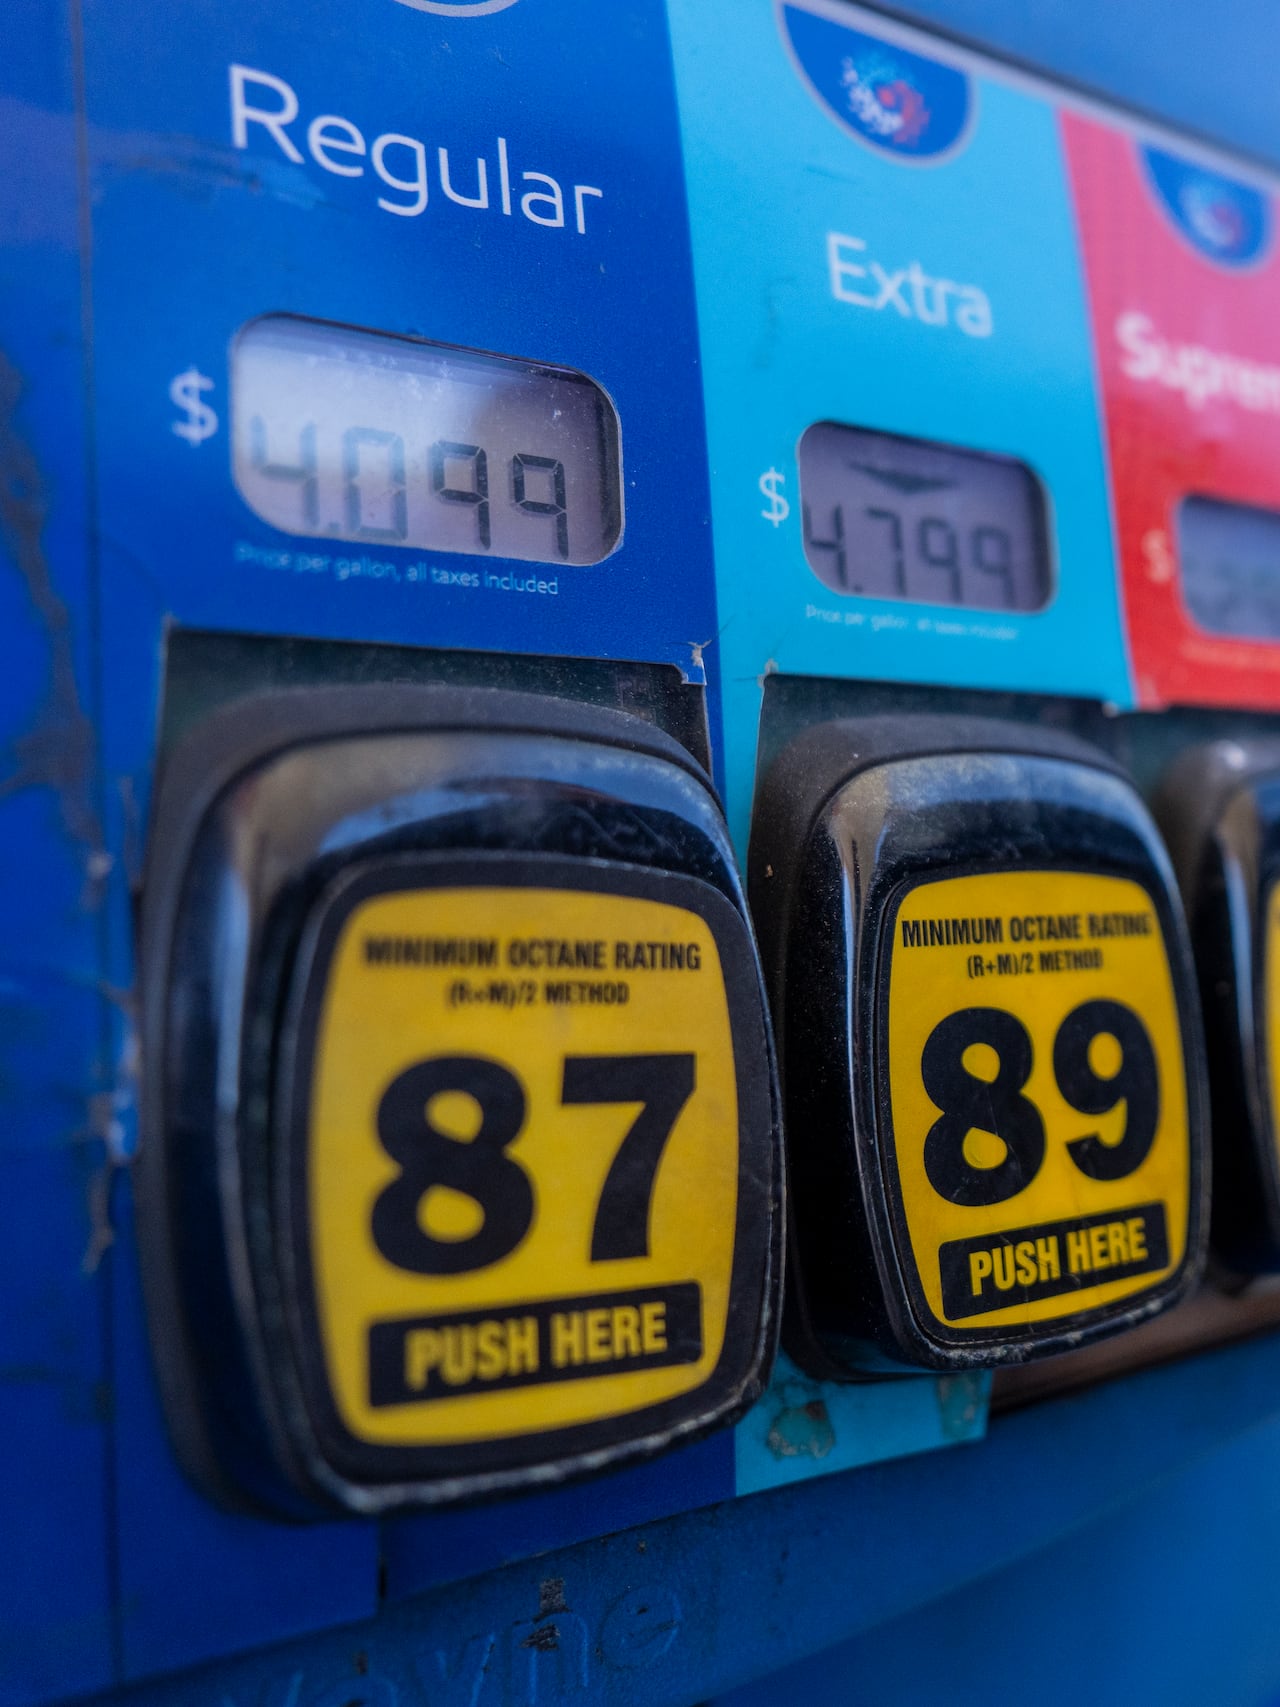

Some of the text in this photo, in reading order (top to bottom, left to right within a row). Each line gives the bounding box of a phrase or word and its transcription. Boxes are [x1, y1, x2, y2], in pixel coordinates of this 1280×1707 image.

[230, 63, 602, 233] Regular
[826, 231, 993, 338] Extra
[169, 367, 569, 559] $ 4.099
[234, 540, 559, 595] Price per gallon, all taxes included
[758, 467, 1017, 605] $ 4.799
[364, 936, 701, 971] MINIMUM OCTANE RATING
[902, 910, 1153, 948] MINIMUM OCTANE RATING
[967, 948, 1104, 979] (R+M)/2 METHOD
[450, 979, 630, 1011] (R+M)/2 METHOD
[921, 997, 1162, 1207] 89
[368, 1051, 697, 1279] 87
[968, 1217, 1149, 1296] PUSH HERE
[406, 1302, 668, 1391] PUSH HERE
